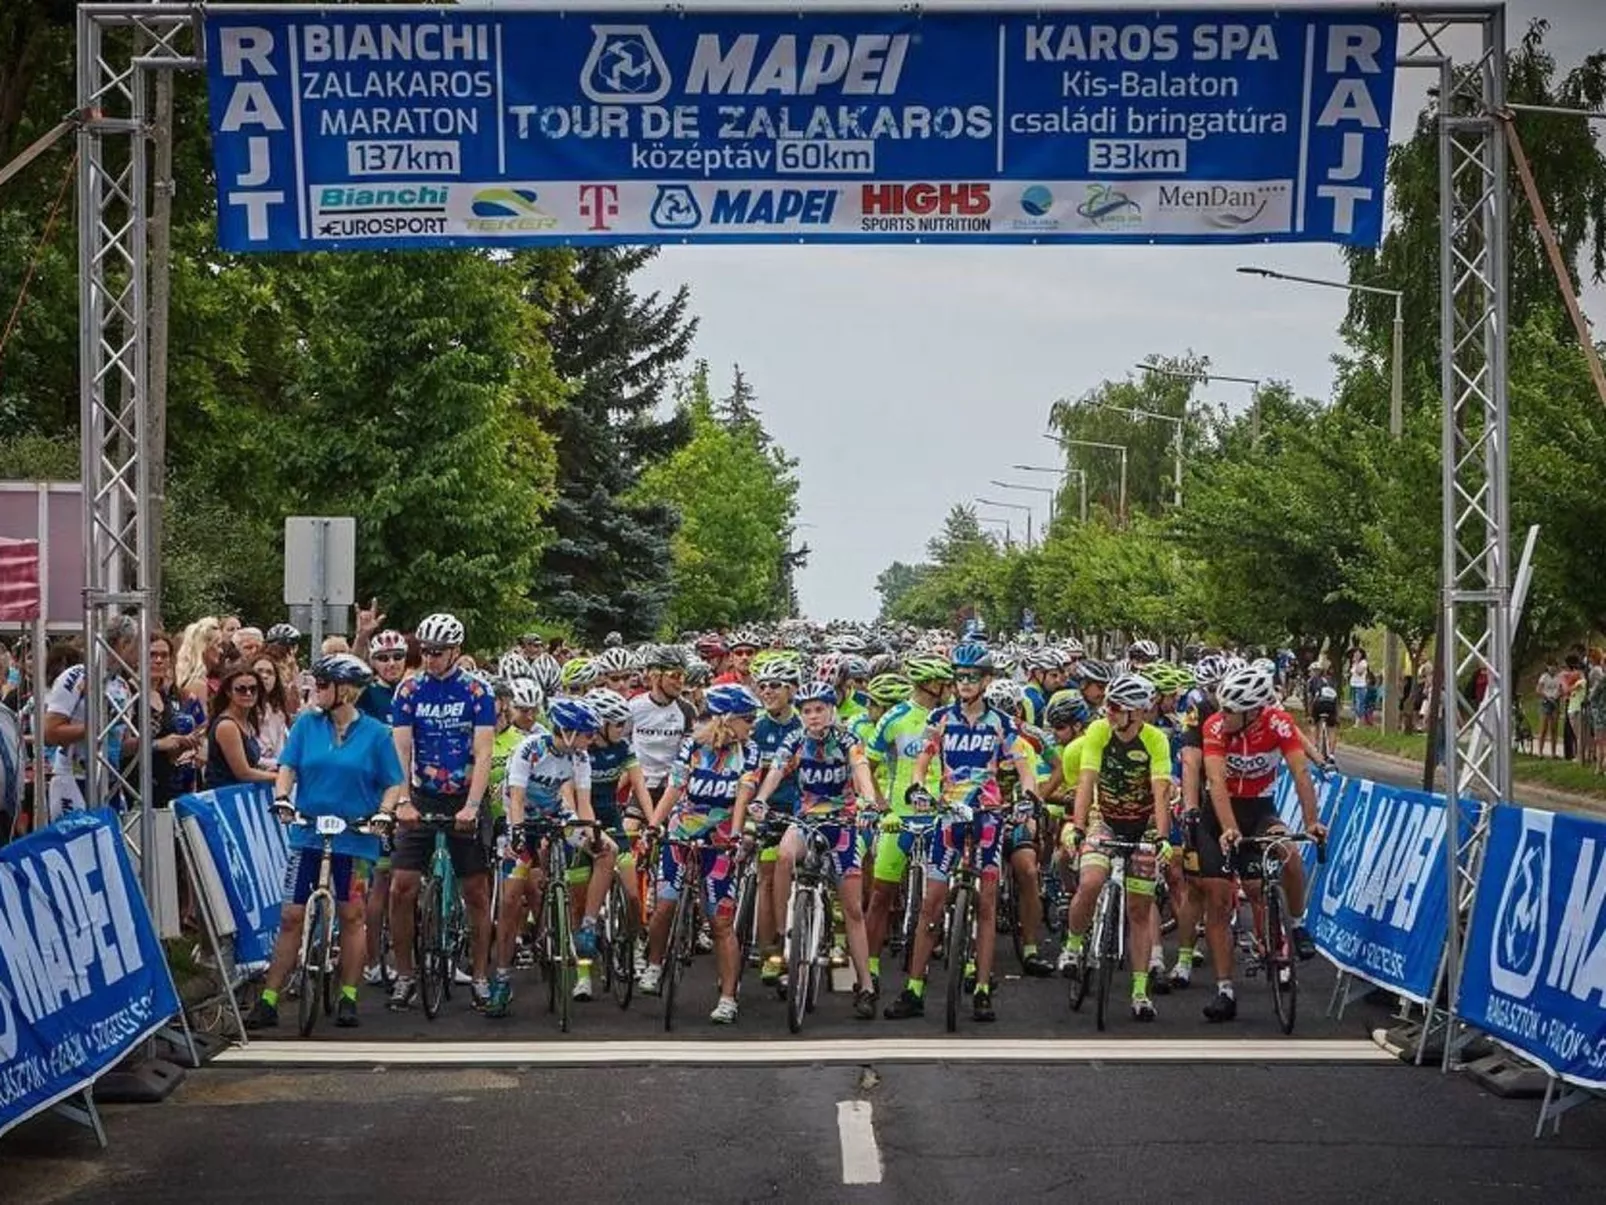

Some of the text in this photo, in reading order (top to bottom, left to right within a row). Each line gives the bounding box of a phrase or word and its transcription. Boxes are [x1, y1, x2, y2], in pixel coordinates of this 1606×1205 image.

[303, 24, 489, 62] BIANCHI
[1024, 24, 1279, 62] KAROS SPA
[685, 33, 909, 96] MAPEI
[302, 70, 493, 100] ZALAKAROS
[1061, 70, 1239, 97] Kis-Balaton
[219, 25, 285, 241] RAJT
[319, 107, 479, 135] MARATON
[509, 104, 993, 140] TOUR DE ZALAKAROS
[1009, 104, 1288, 140] családi bringatúra
[1316, 23, 1382, 235] RAJT
[356, 144, 456, 172] 137km
[631, 143, 873, 176] középtáv 60km
[1093, 143, 1181, 170] 33km
[319, 186, 448, 207] Bianchi
[579, 184, 619, 231] T
[709, 189, 839, 225] MAPEI
[861, 183, 991, 216] HIGH5
[1158, 185, 1256, 208] MenDan
[331, 217, 448, 236] EUROSPORT
[861, 216, 991, 232] SPORTS NUTRITION
[415, 701, 466, 718] MAPEI
[688, 776, 739, 799] MAPE
[1344, 797, 1448, 933] MAPEI
[0, 825, 144, 1025] MAPEI
